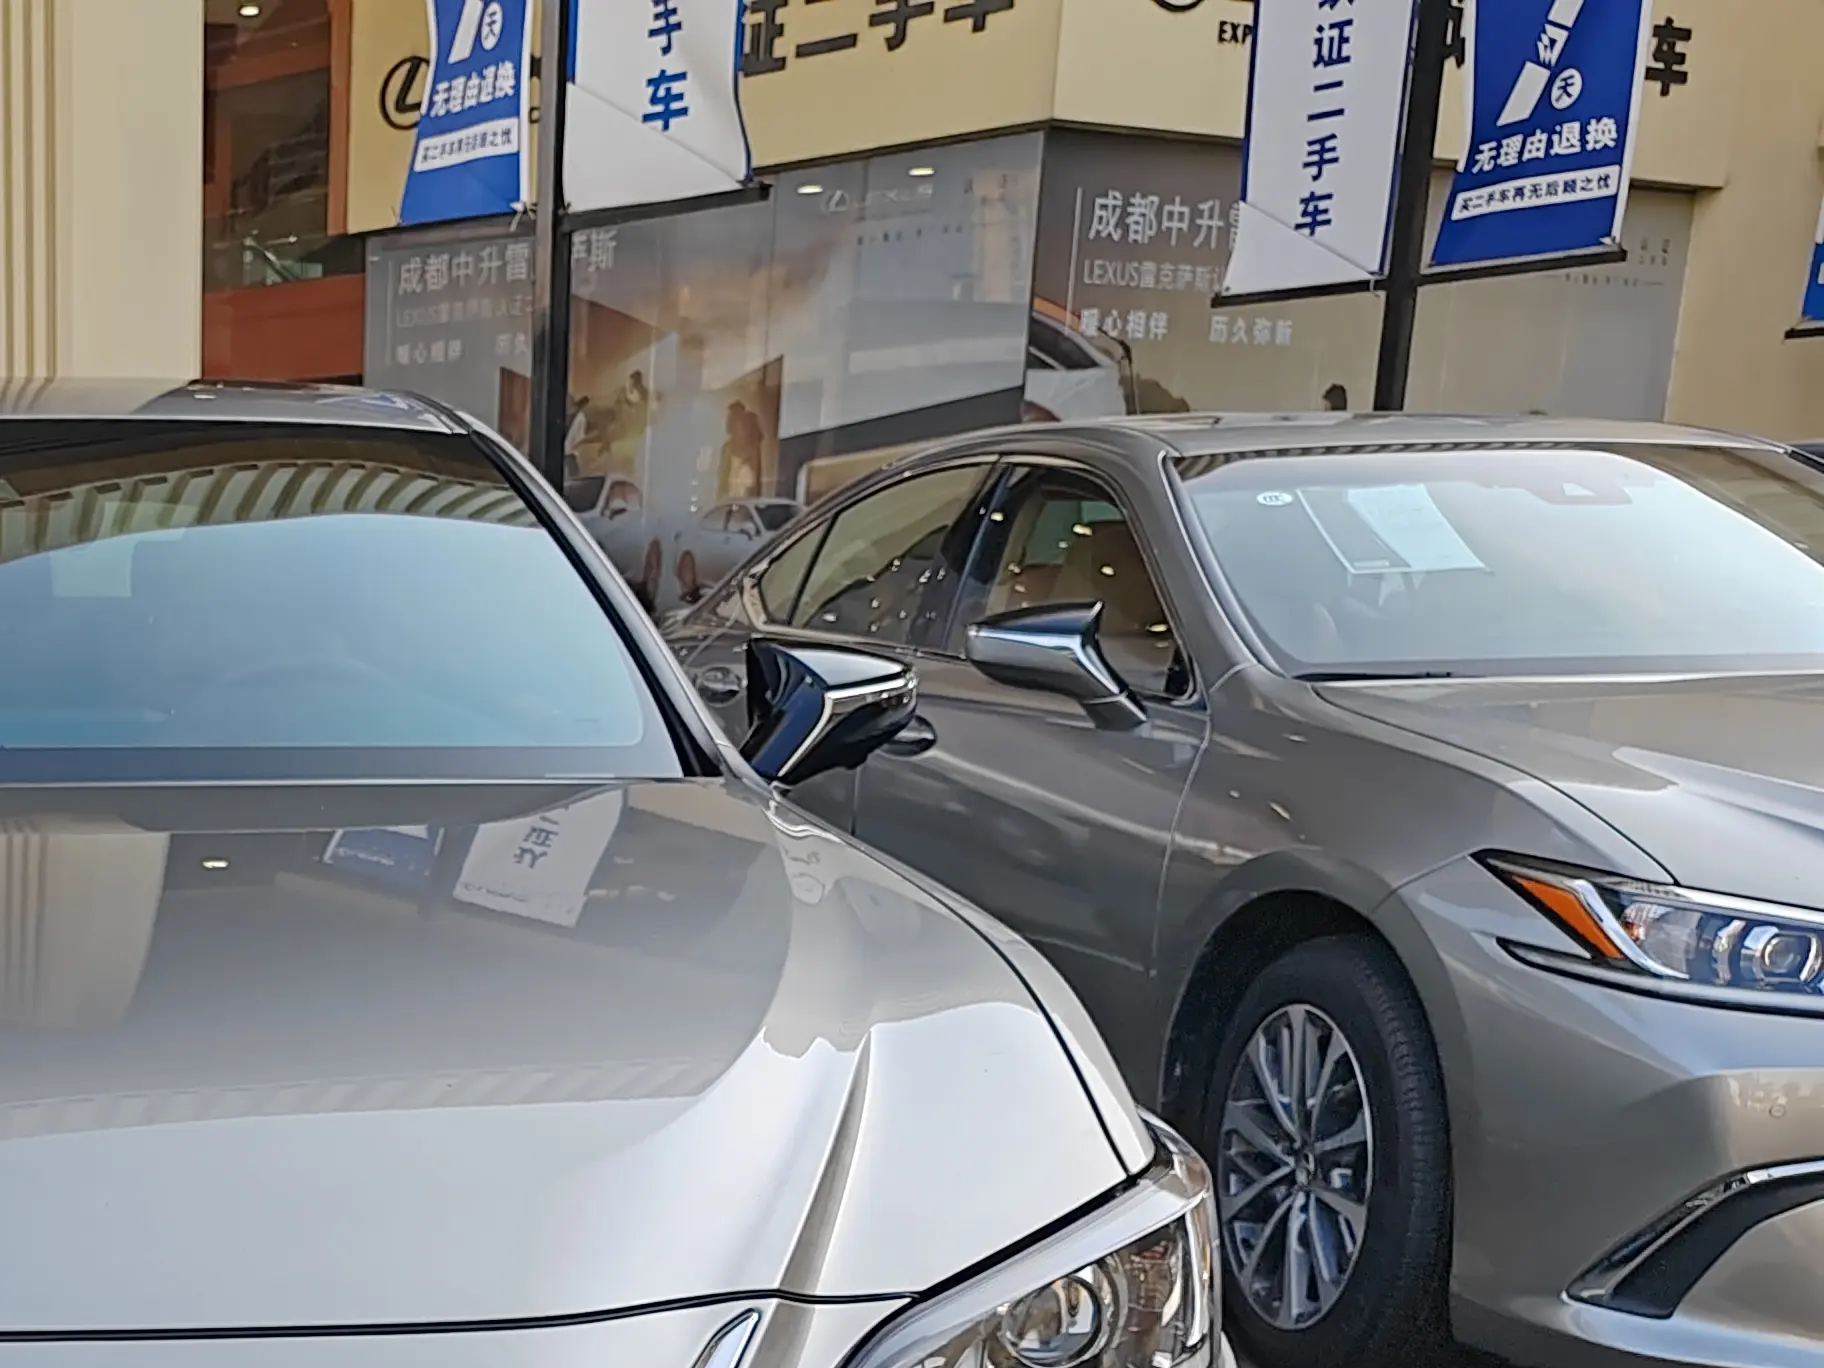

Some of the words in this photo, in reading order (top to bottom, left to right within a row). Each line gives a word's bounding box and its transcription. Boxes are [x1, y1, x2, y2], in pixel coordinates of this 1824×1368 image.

[1294, 0, 1364, 237] 证二手车
[1472, 117, 1619, 175] 无理由退换
